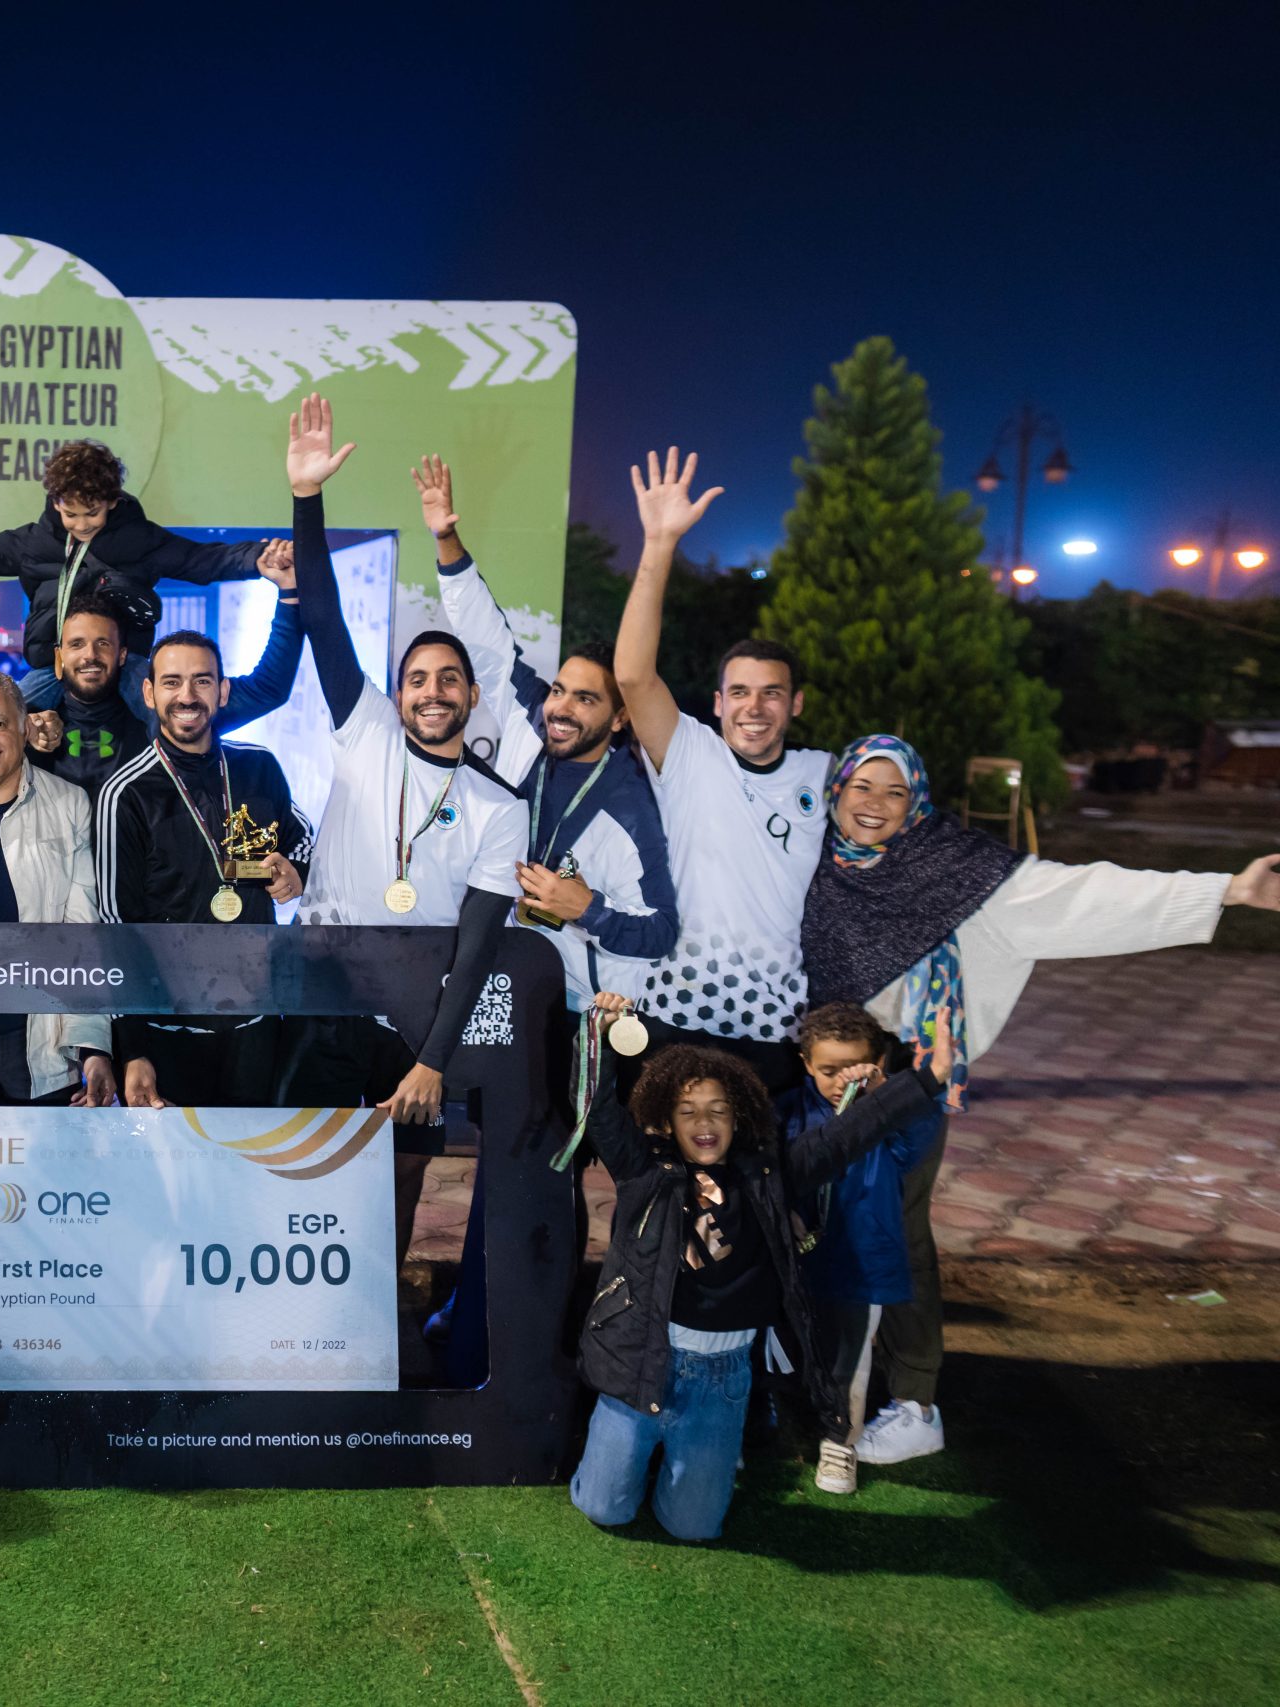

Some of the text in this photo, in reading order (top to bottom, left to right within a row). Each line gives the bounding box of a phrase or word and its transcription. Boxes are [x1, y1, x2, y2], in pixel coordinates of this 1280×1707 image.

[766, 812, 791, 854] 9
[37, 1190, 111, 1216] one
[49, 1217, 100, 1225] FINANCE
[287, 1213, 346, 1235] EGP.
[39, 1258, 103, 1278] Place
[179, 1243, 352, 1294] 10,000
[50, 1292, 96, 1305] Pound
[12, 1338, 62, 1351] 436346
[270, 1339, 296, 1350] DATE
[302, 1340, 312, 1350] 12
[322, 1340, 346, 1350] 2022
[106, 1432, 472, 1450] Take a picture and mention us @Onefinance.eg
